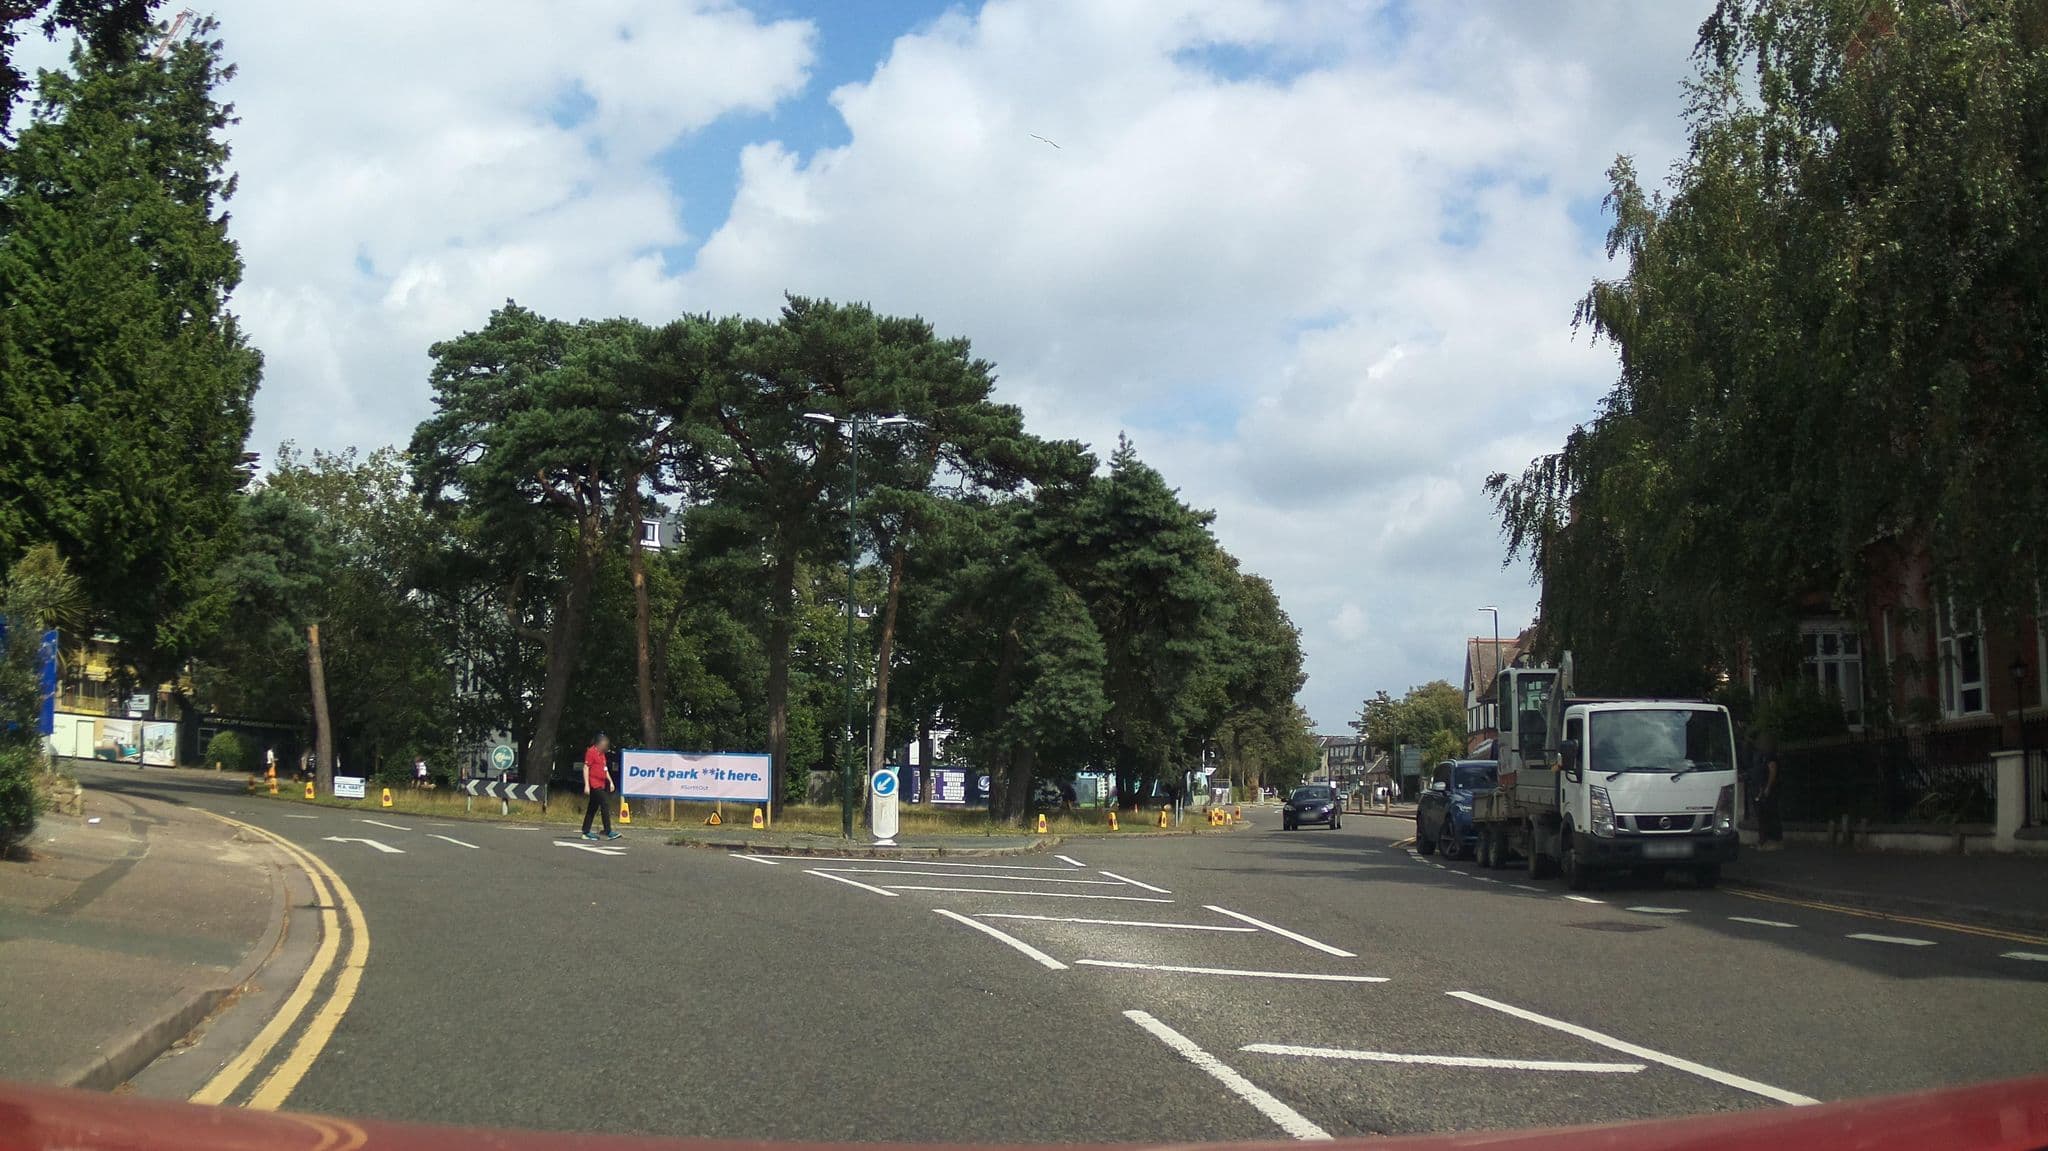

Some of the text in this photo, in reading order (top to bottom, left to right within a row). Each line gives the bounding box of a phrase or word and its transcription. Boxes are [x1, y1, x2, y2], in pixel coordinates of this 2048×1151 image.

[629, 766, 666, 778] Don't
[667, 769, 699, 781] park
[728, 770, 762, 782] here.
